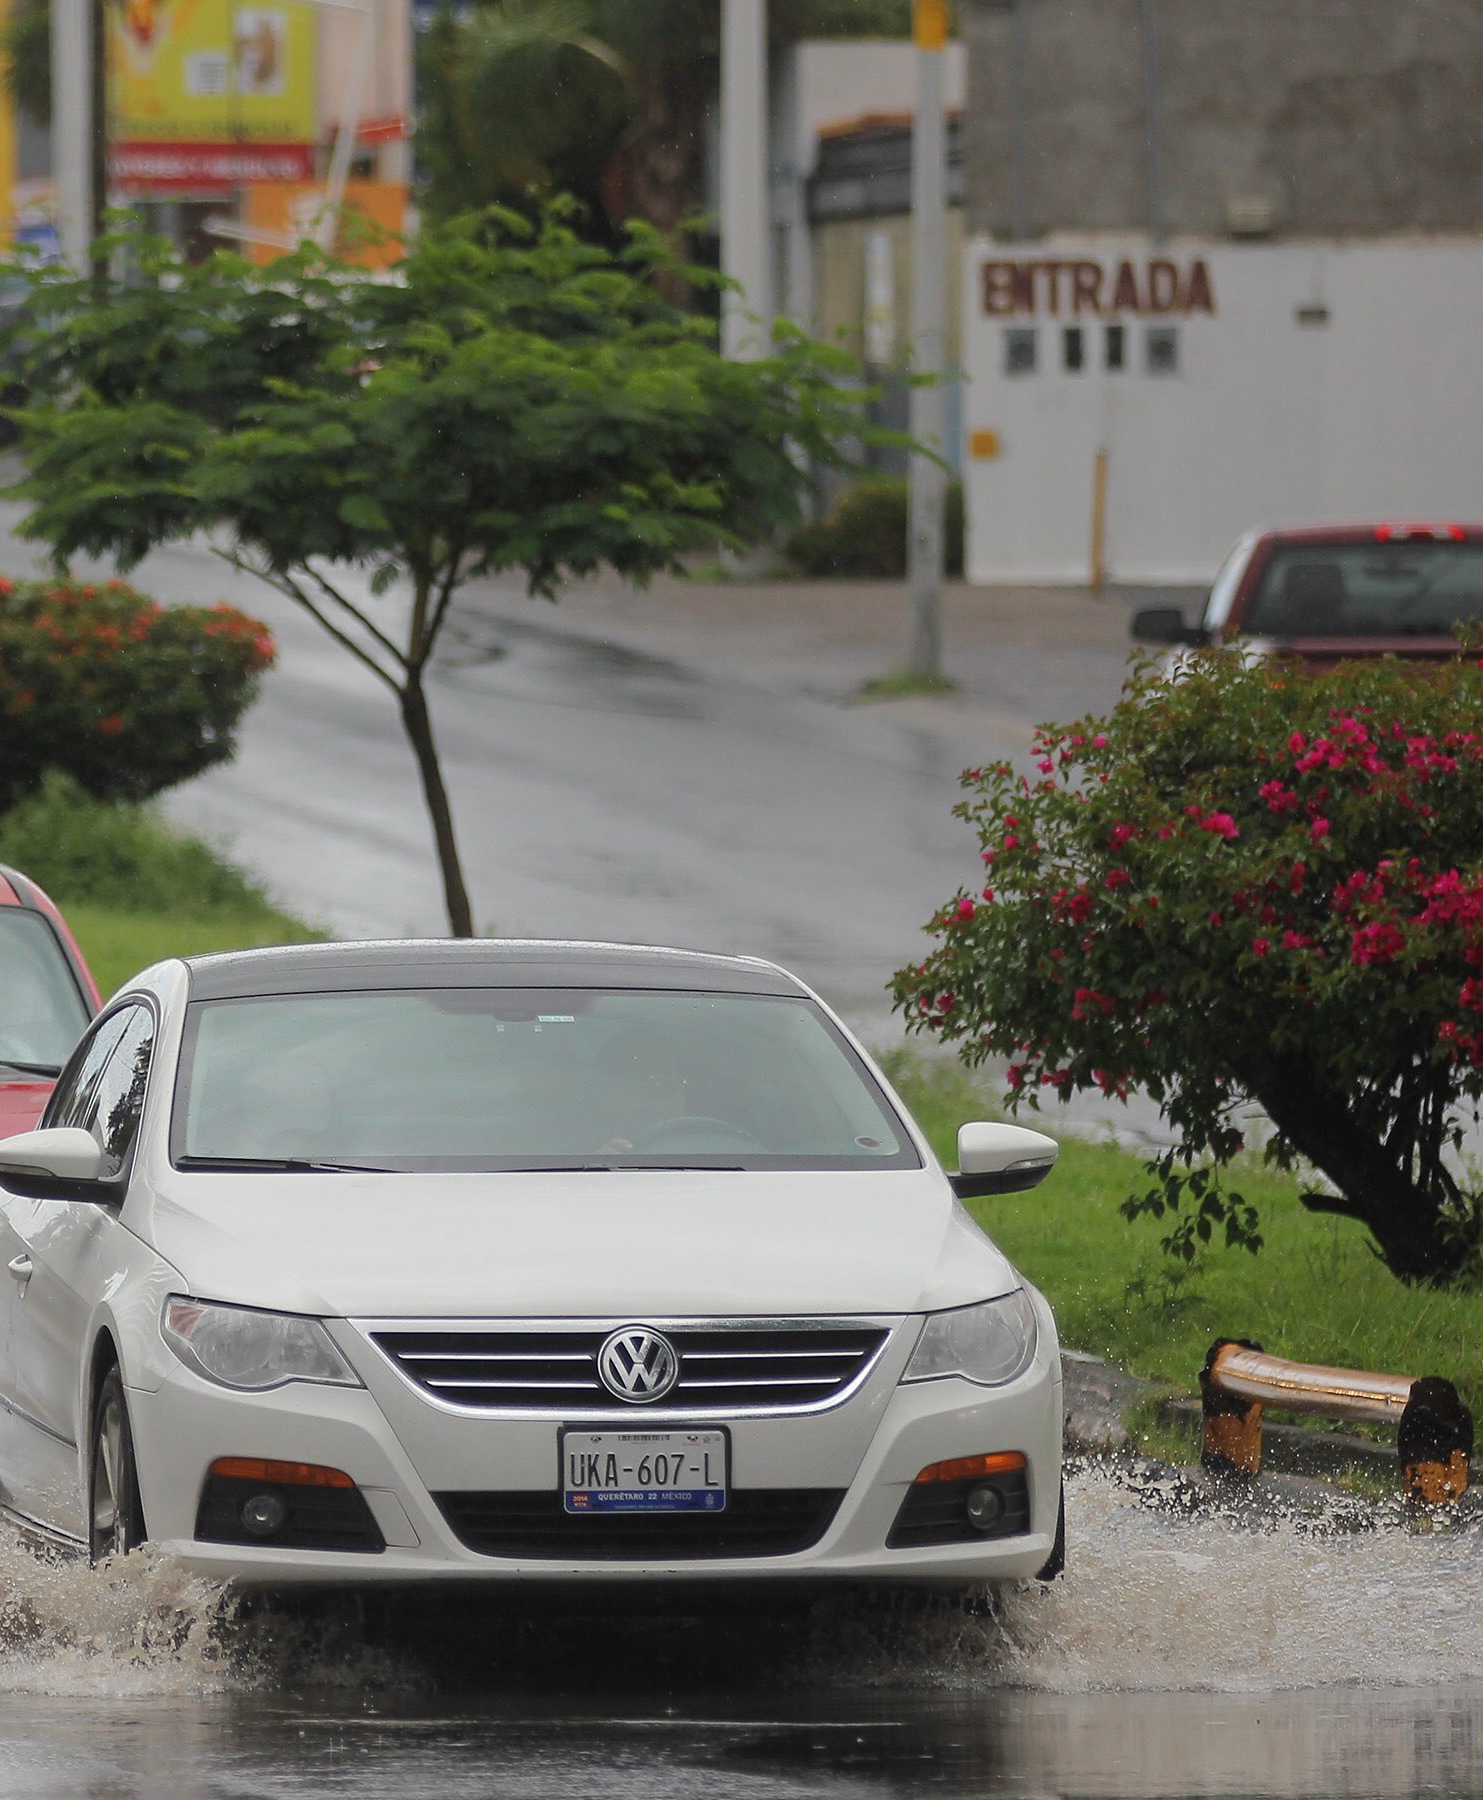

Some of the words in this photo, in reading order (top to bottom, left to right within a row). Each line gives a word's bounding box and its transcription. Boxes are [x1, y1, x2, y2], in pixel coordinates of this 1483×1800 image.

[982, 260, 1215, 316] ENTRADA
[570, 1453, 718, 1487] UKA-607-L
[597, 1492, 644, 1501] QUERÉTARO
[648, 1493, 658, 1501] 22
[661, 1491, 692, 1501] MÉXICO
